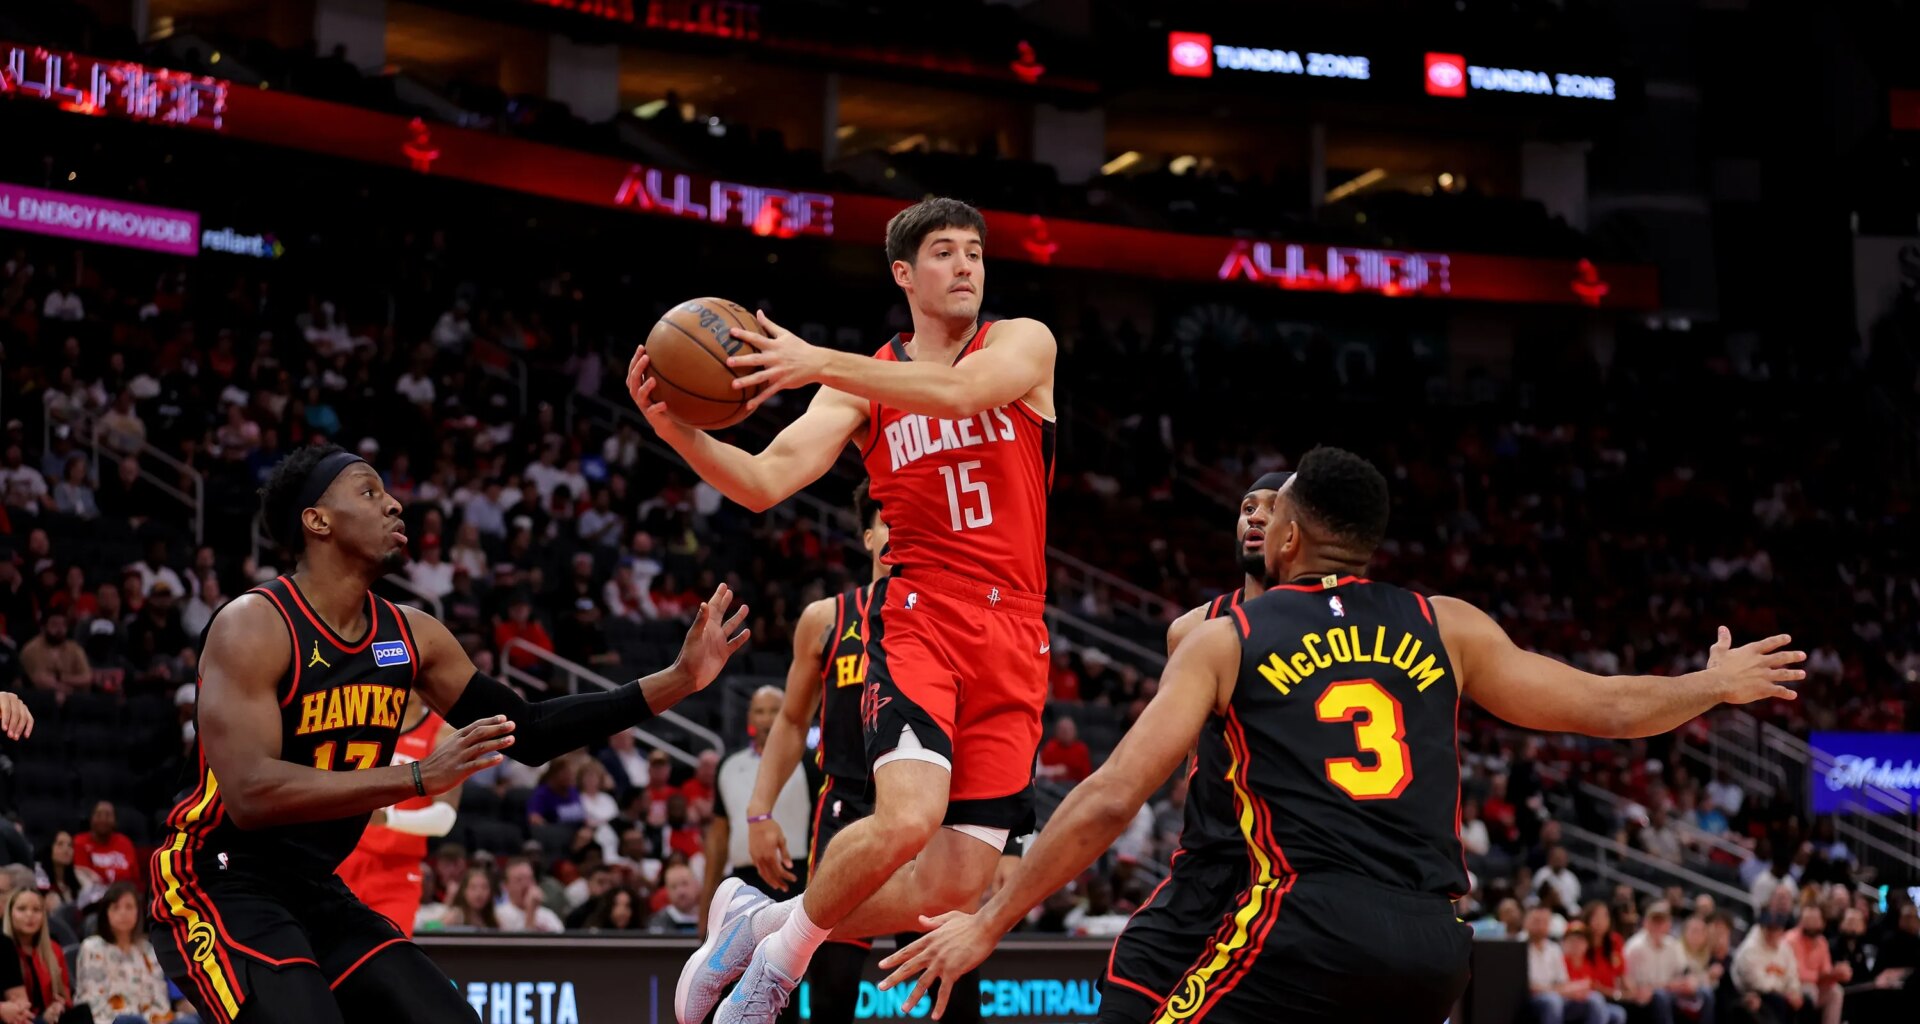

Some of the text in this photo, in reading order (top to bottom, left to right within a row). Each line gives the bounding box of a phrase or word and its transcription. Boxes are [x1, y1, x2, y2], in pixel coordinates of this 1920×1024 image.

[1213, 45, 1370, 79] TUNDRA ZONE
[1467, 65, 1616, 100] TUNDRA ZONE
[18, 196, 97, 229] ENERGY
[97, 208, 192, 243] PROVIDER
[202, 227, 263, 257] reliant
[884, 404, 1016, 473] ROCKETS
[938, 460, 993, 532] 15
[376, 646, 404, 661] paze
[1257, 625, 1446, 696] McCOLLUM
[294, 683, 407, 737] HAWKS
[1314, 678, 1414, 800] 3
[466, 981, 580, 1024] THETA
